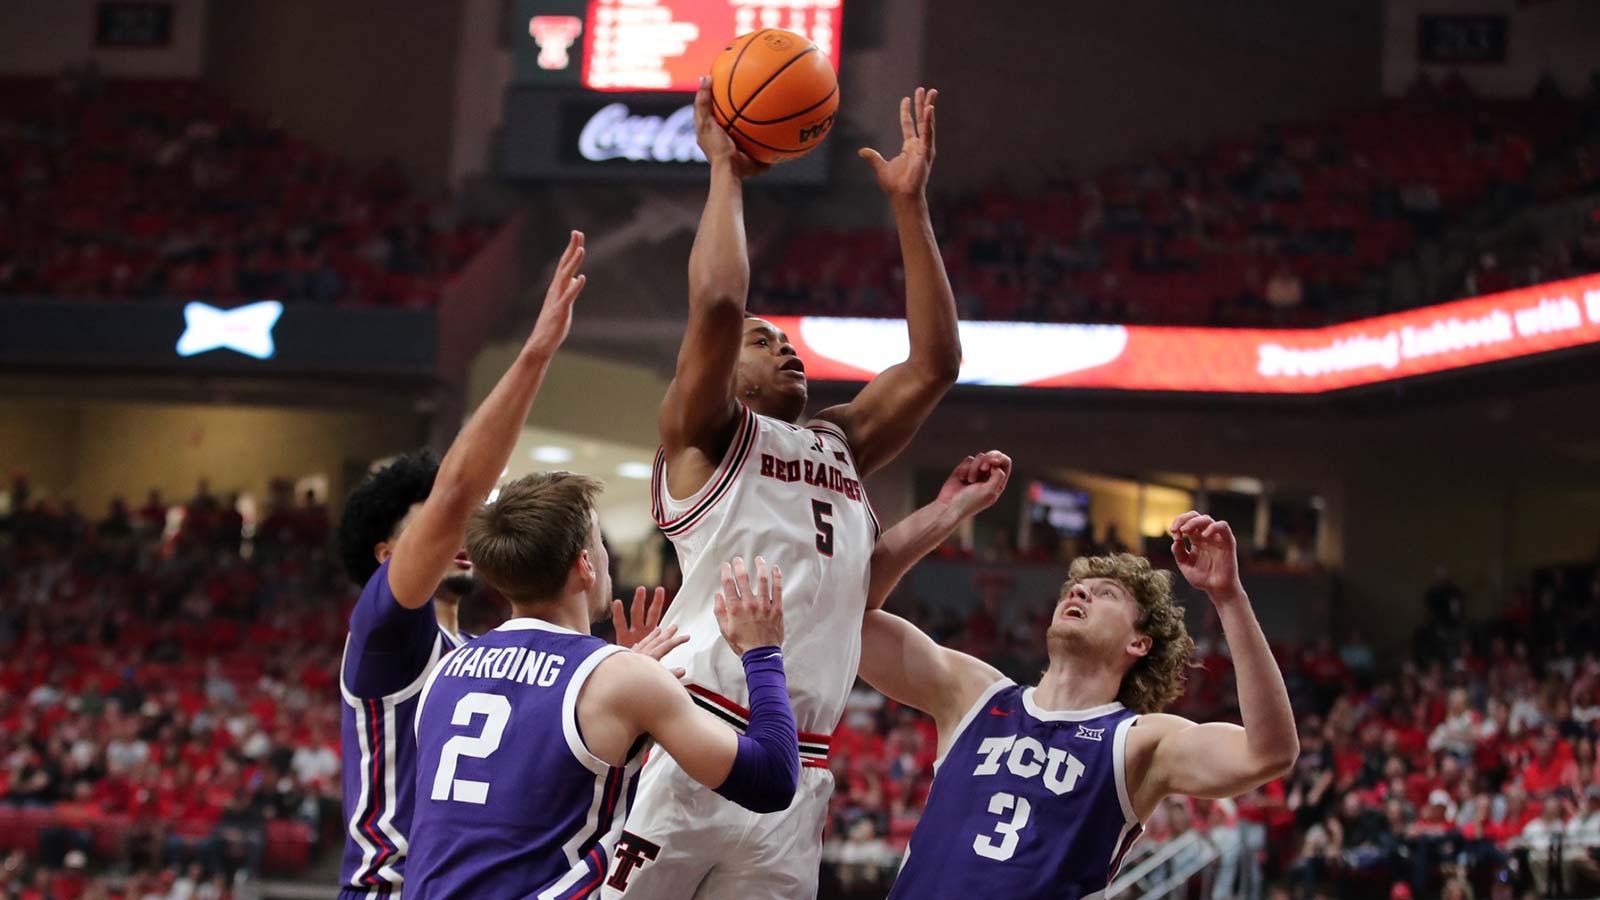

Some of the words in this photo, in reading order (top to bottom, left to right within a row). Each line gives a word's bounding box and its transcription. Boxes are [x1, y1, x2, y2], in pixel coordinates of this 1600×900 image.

[760, 453, 801, 483] RED
[804, 460, 862, 503] RAIDRS
[811, 498, 834, 558] 5
[444, 646, 566, 687] HARDING
[431, 692, 512, 805] 2
[972, 733, 1086, 796] TCU
[972, 791, 1031, 862] 3
